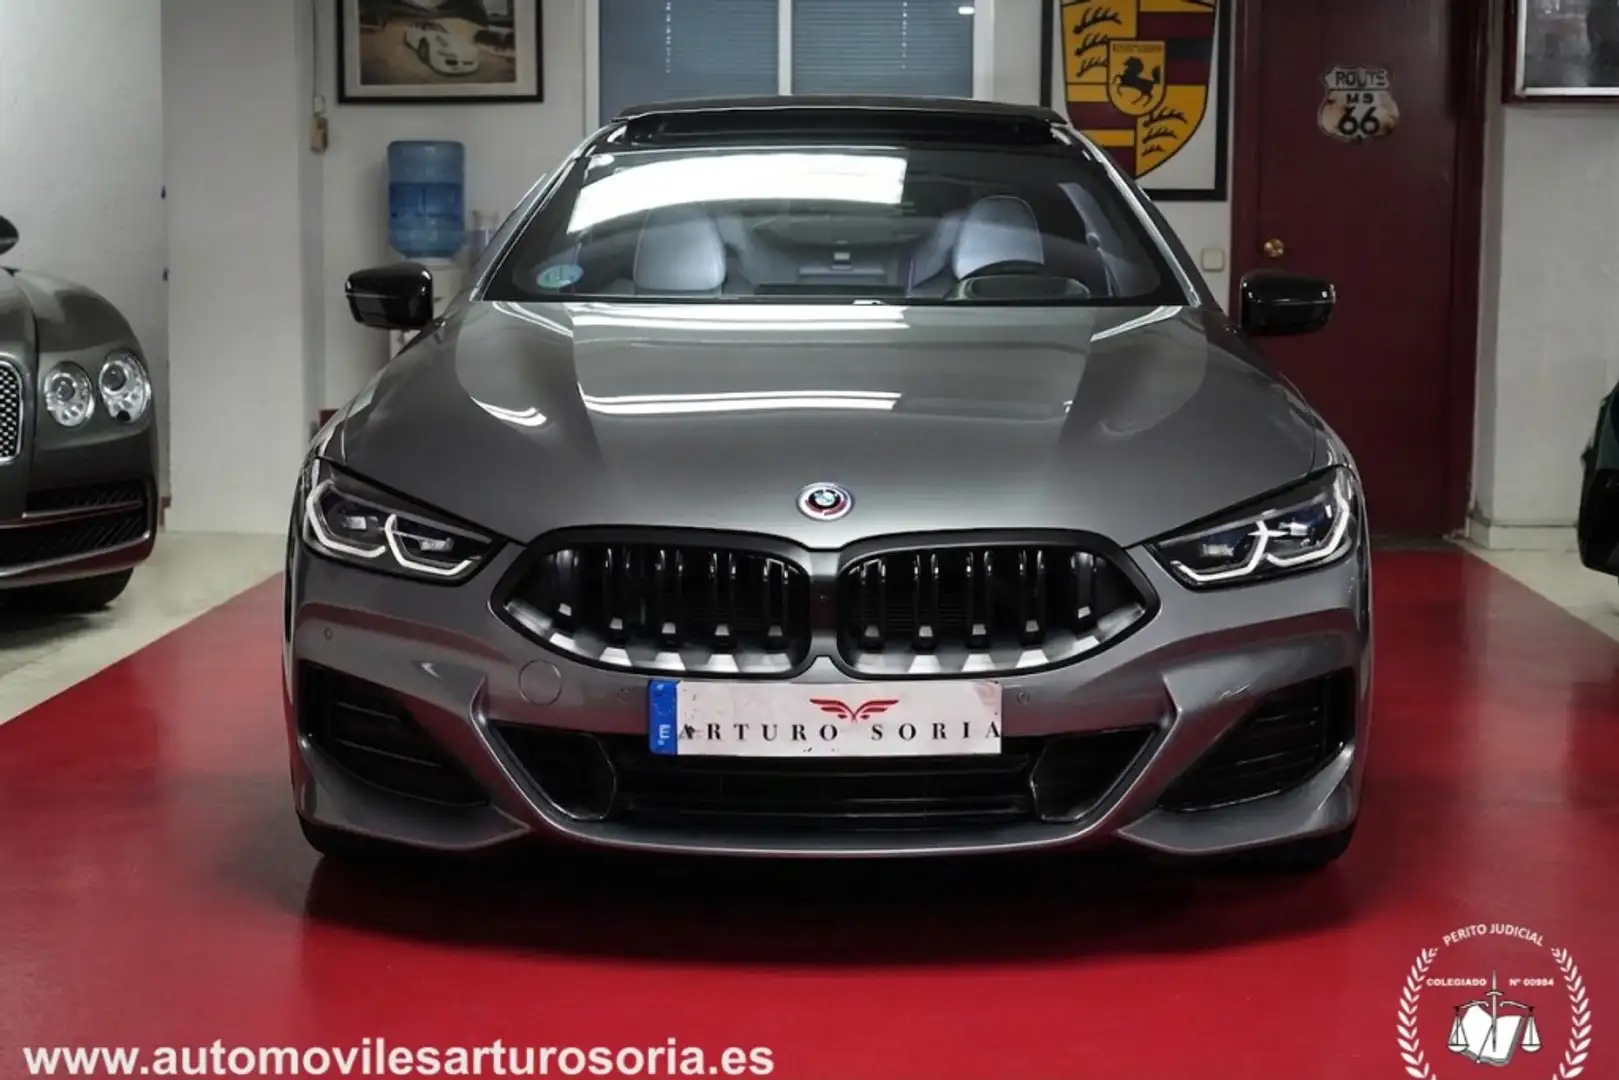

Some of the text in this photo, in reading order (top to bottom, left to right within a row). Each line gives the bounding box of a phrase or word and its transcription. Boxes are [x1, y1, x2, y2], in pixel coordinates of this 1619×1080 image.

[1335, 70, 1386, 89] ROUTE
[1338, 105, 1380, 135] 66
[659, 723, 671, 739] E
[678, 721, 1001, 741] ARTURO SORIA
